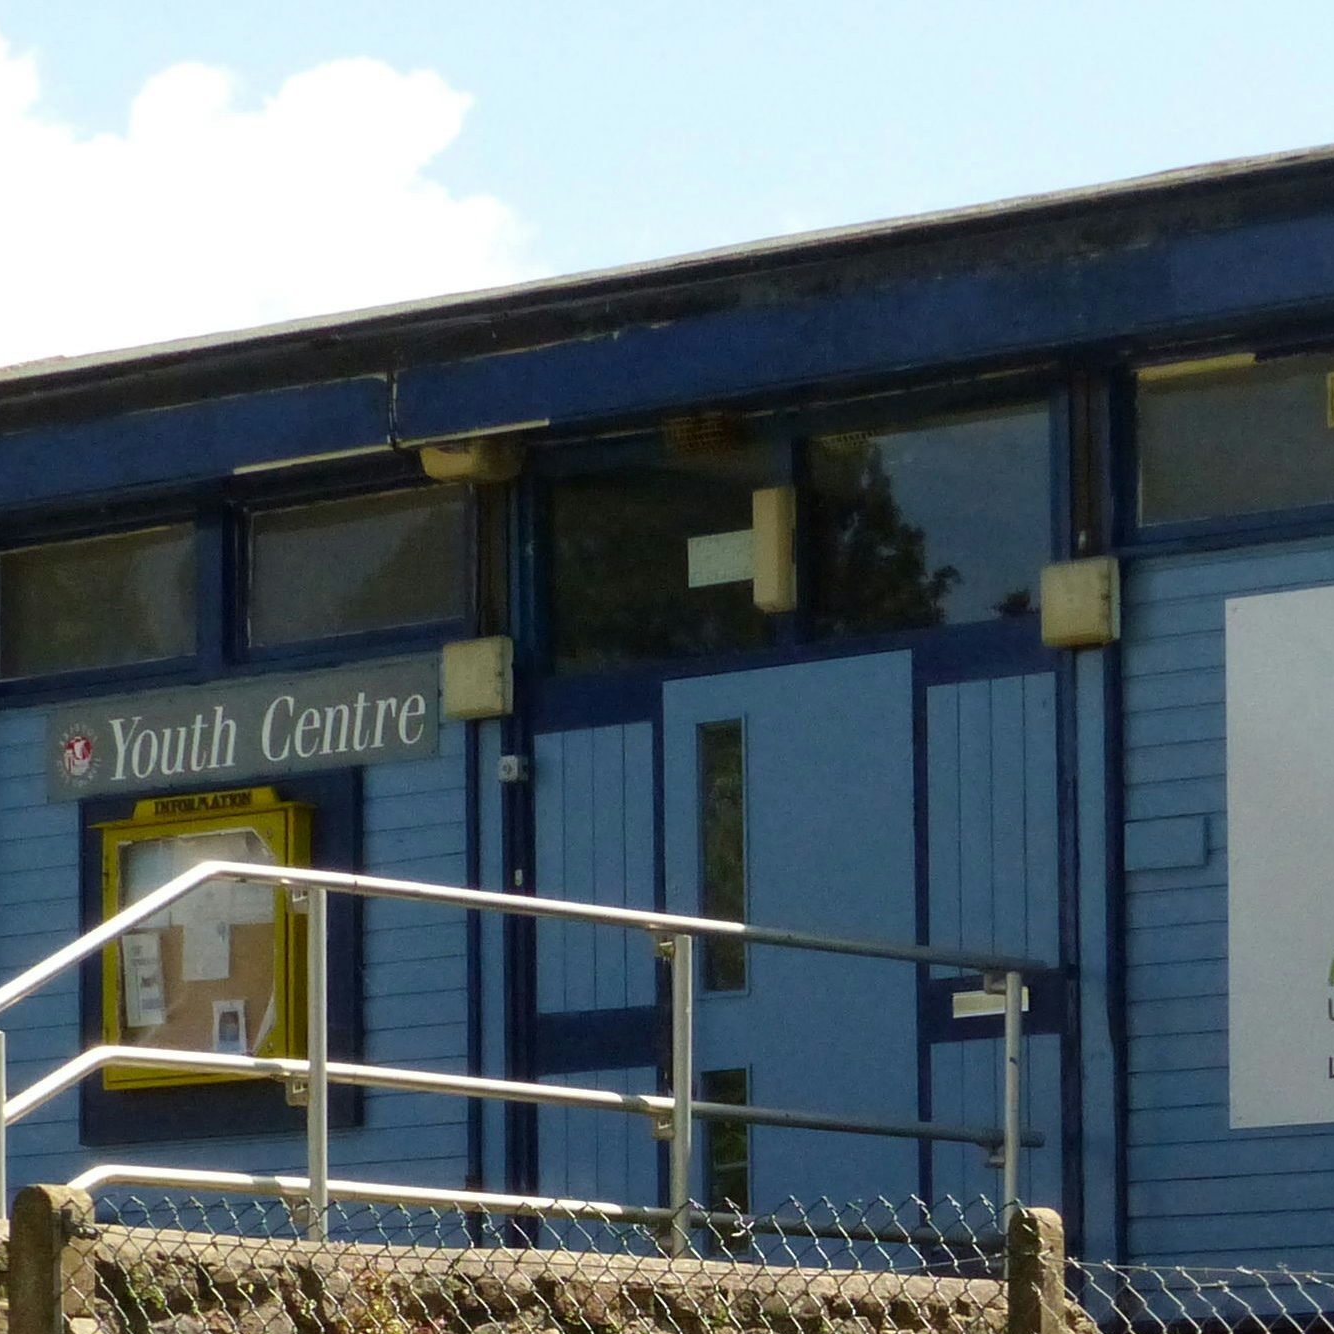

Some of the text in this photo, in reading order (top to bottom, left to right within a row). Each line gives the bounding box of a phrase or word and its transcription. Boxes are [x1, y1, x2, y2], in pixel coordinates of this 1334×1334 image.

[108, 706, 236, 781] Youth
[261, 692, 427, 762] Centre
[154, 791, 252, 815] INFORMATION
